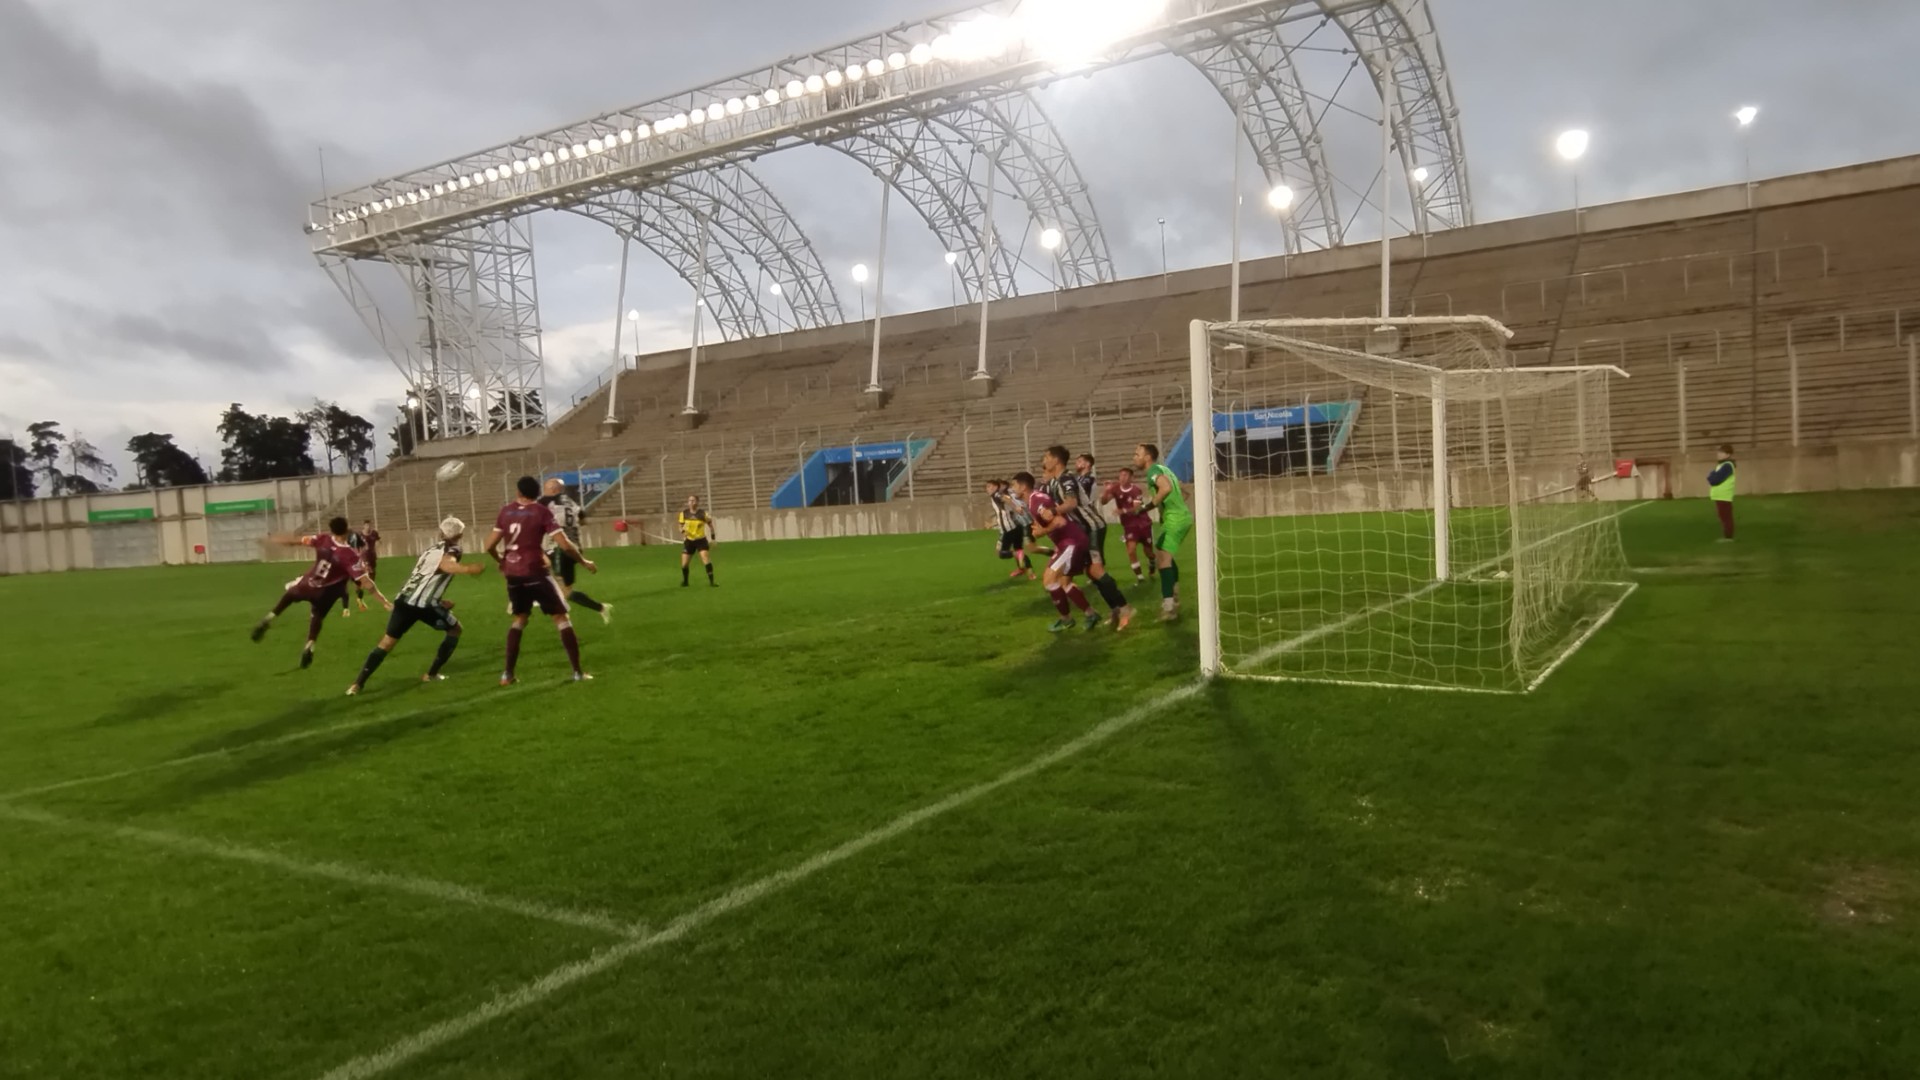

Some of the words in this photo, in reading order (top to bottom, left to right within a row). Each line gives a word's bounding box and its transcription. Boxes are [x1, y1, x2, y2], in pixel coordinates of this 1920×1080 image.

[564, 506, 575, 527] 6
[505, 522, 522, 551] 2
[315, 559, 332, 579] 8
